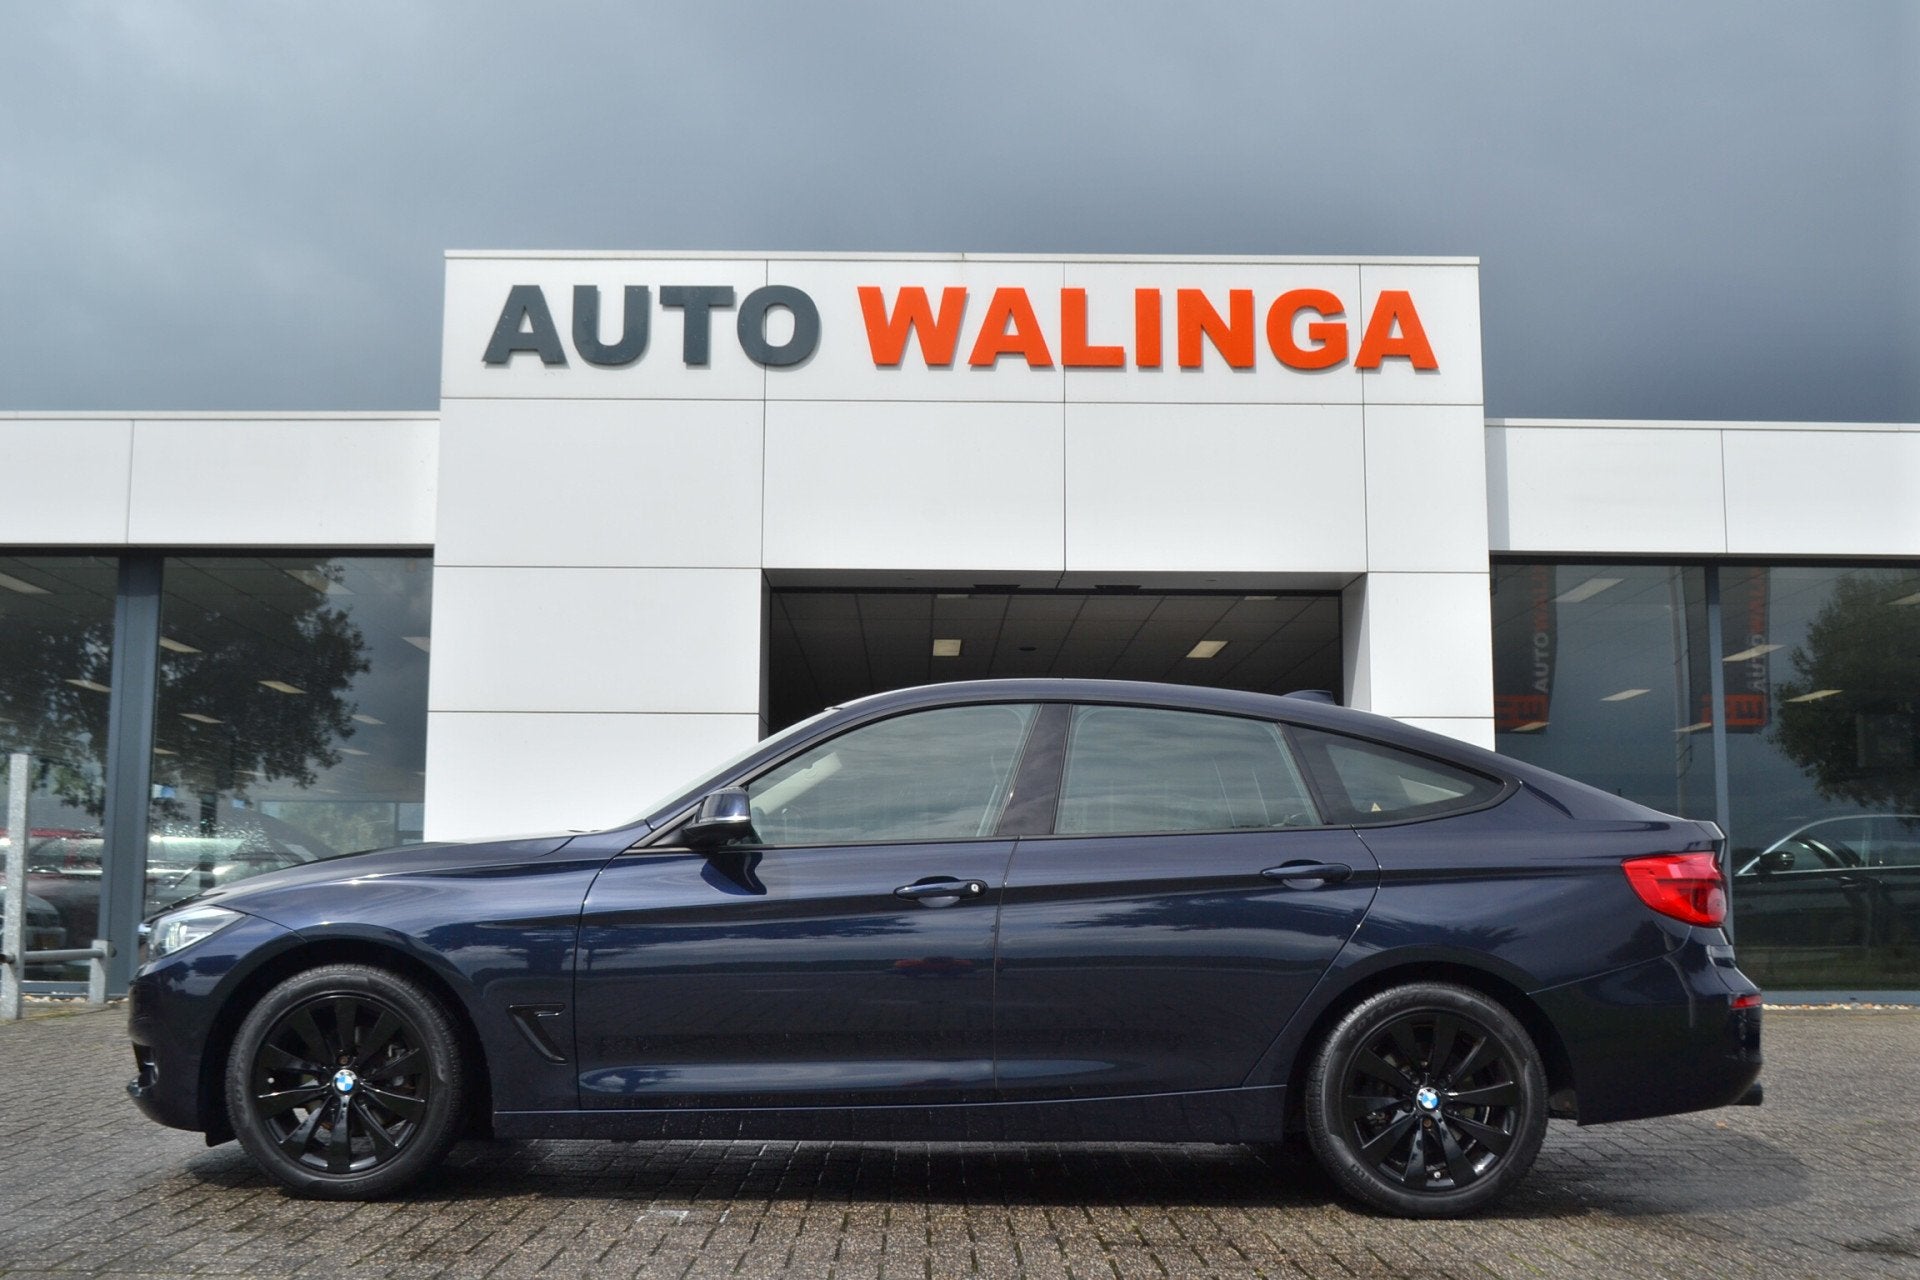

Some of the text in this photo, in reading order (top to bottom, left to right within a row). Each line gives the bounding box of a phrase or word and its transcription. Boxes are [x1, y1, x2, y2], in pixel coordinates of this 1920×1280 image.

[482, 285, 1438, 370] AUTO WALINGA
[1533, 632, 1548, 693] AUTO
